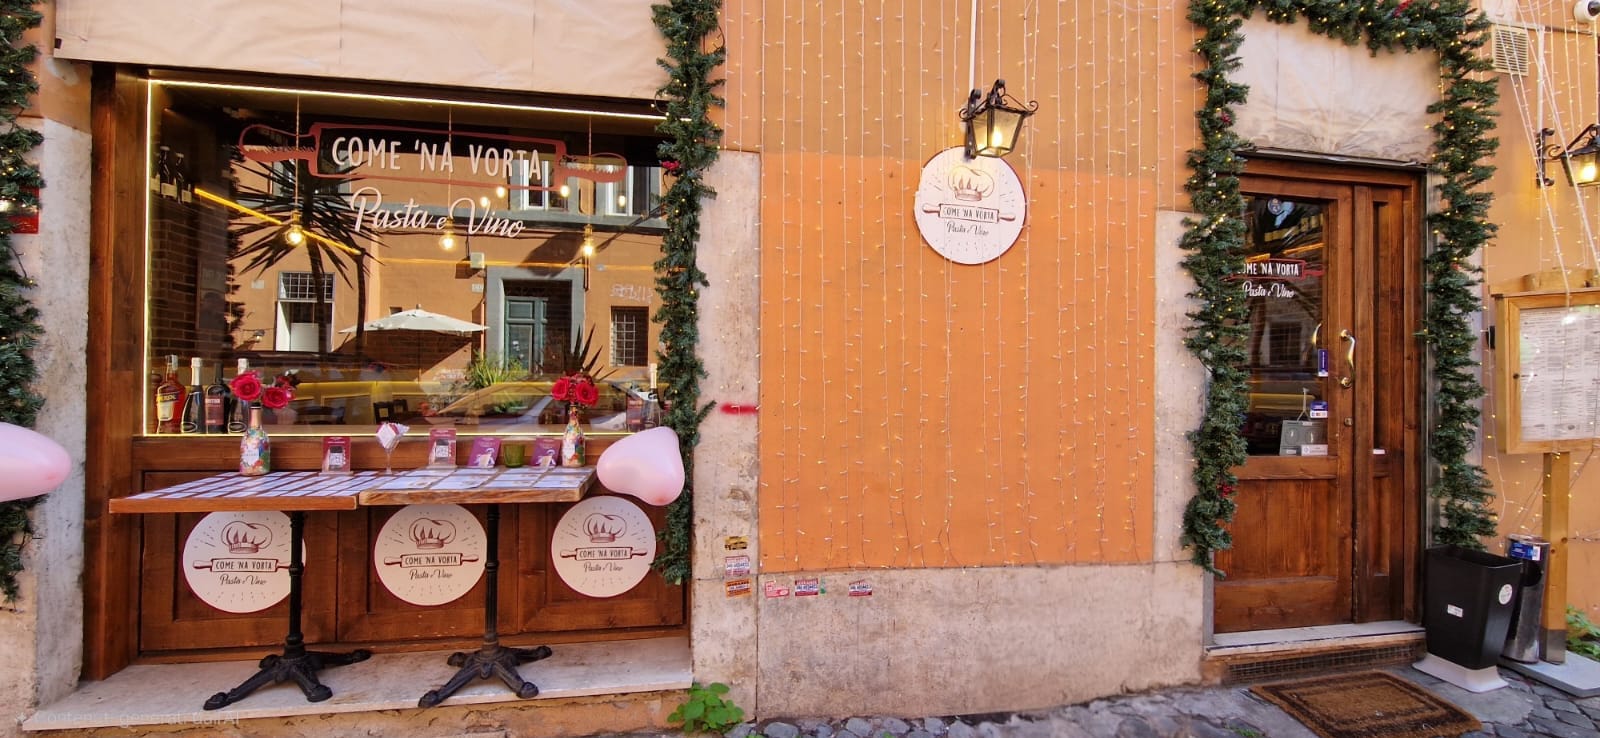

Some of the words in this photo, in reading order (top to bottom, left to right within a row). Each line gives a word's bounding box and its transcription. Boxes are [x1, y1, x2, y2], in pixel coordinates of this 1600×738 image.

[332, 136, 401, 170] COME
[415, 139, 454, 173] 'NA
[469, 144, 542, 180] VORTA
[350, 186, 434, 233] Pasta
[436, 216, 447, 230] e
[449, 197, 526, 238] Vino
[943, 206, 960, 217] COME
[975, 209, 994, 220] VORTA
[946, 220, 966, 233] Pasta
[1276, 262, 1299, 276] VORTA
[1242, 280, 1267, 299] Pasta
[1271, 283, 1296, 298] Vino
[405, 556, 422, 565] COME
[438, 555, 457, 564] VORTA
[579, 550, 595, 558] COME
[610, 549, 628, 557] VORTA
[215, 561, 234, 570] COME
[252, 561, 272, 569] VORTA
[583, 561, 602, 572] Pasta
[219, 573, 241, 586] Pasta
[409, 568, 429, 580] Pasta
